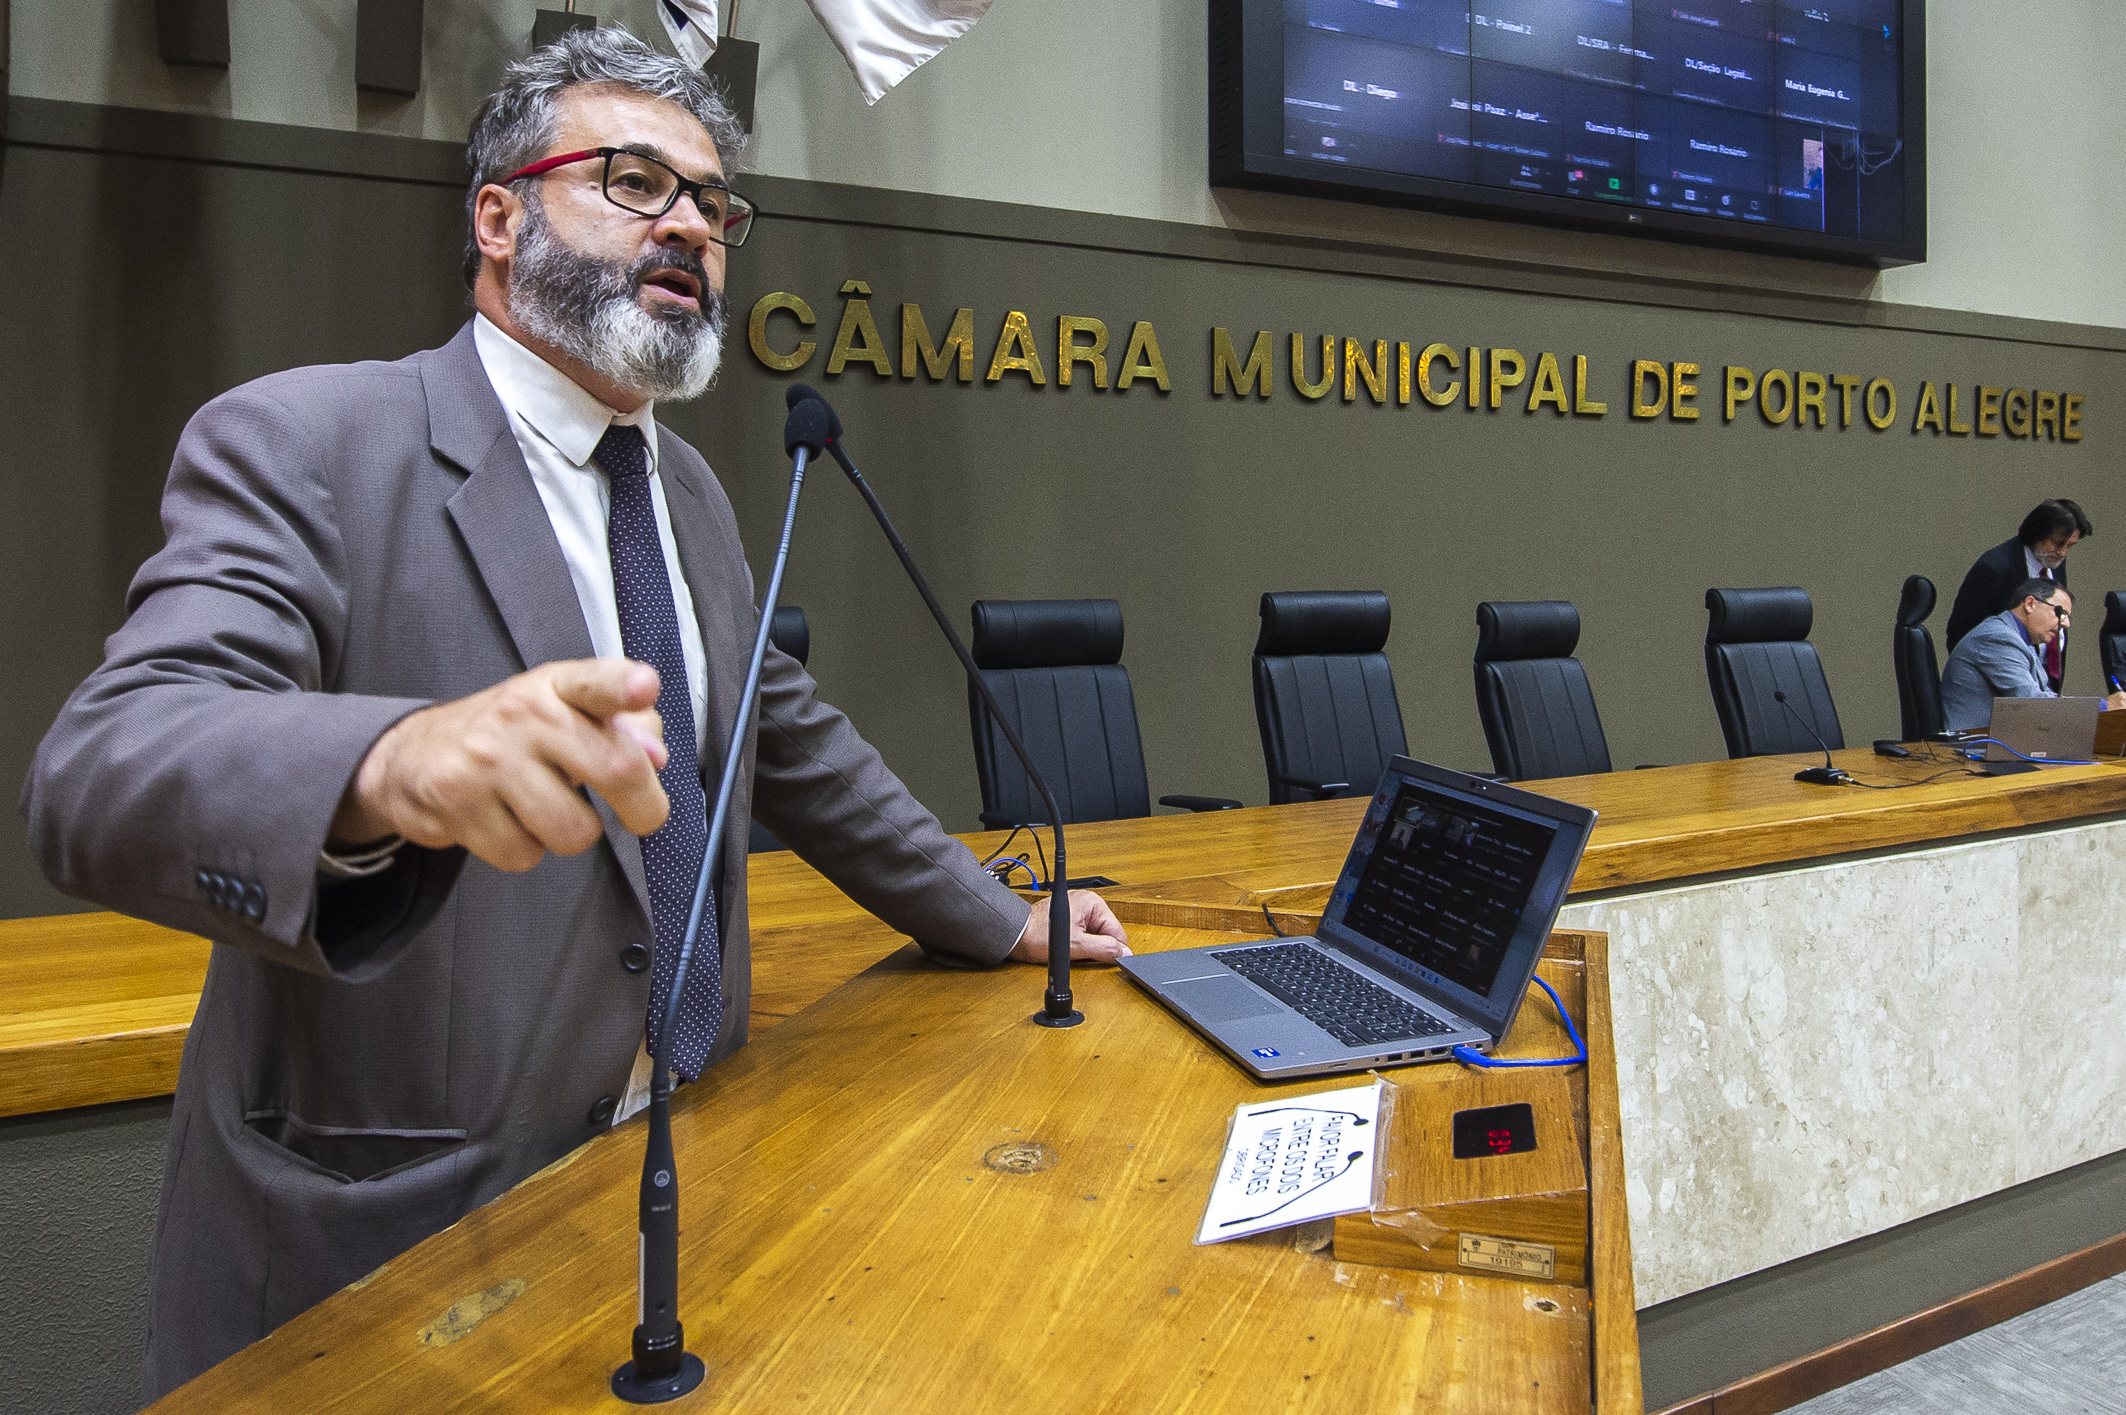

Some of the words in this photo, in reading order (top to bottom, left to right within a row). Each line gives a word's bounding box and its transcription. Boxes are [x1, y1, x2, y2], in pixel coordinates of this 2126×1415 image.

[748, 280, 1171, 392] CÂMARA
[1211, 326, 1607, 416] MUNICIPAL
[1633, 359, 1701, 419] DE
[1724, 365, 1897, 429] PORTO
[1916, 381, 2086, 441] ALEGRE
[1288, 1117, 1314, 1150] ENTRE
[1318, 1115, 1344, 1149] FAVOR
[1245, 1127, 1283, 1195] MICROFONES
[1284, 1150, 1308, 1166] OS
[1311, 1147, 1339, 1182] FALAR
[1277, 1166, 1304, 1194] DOIS
